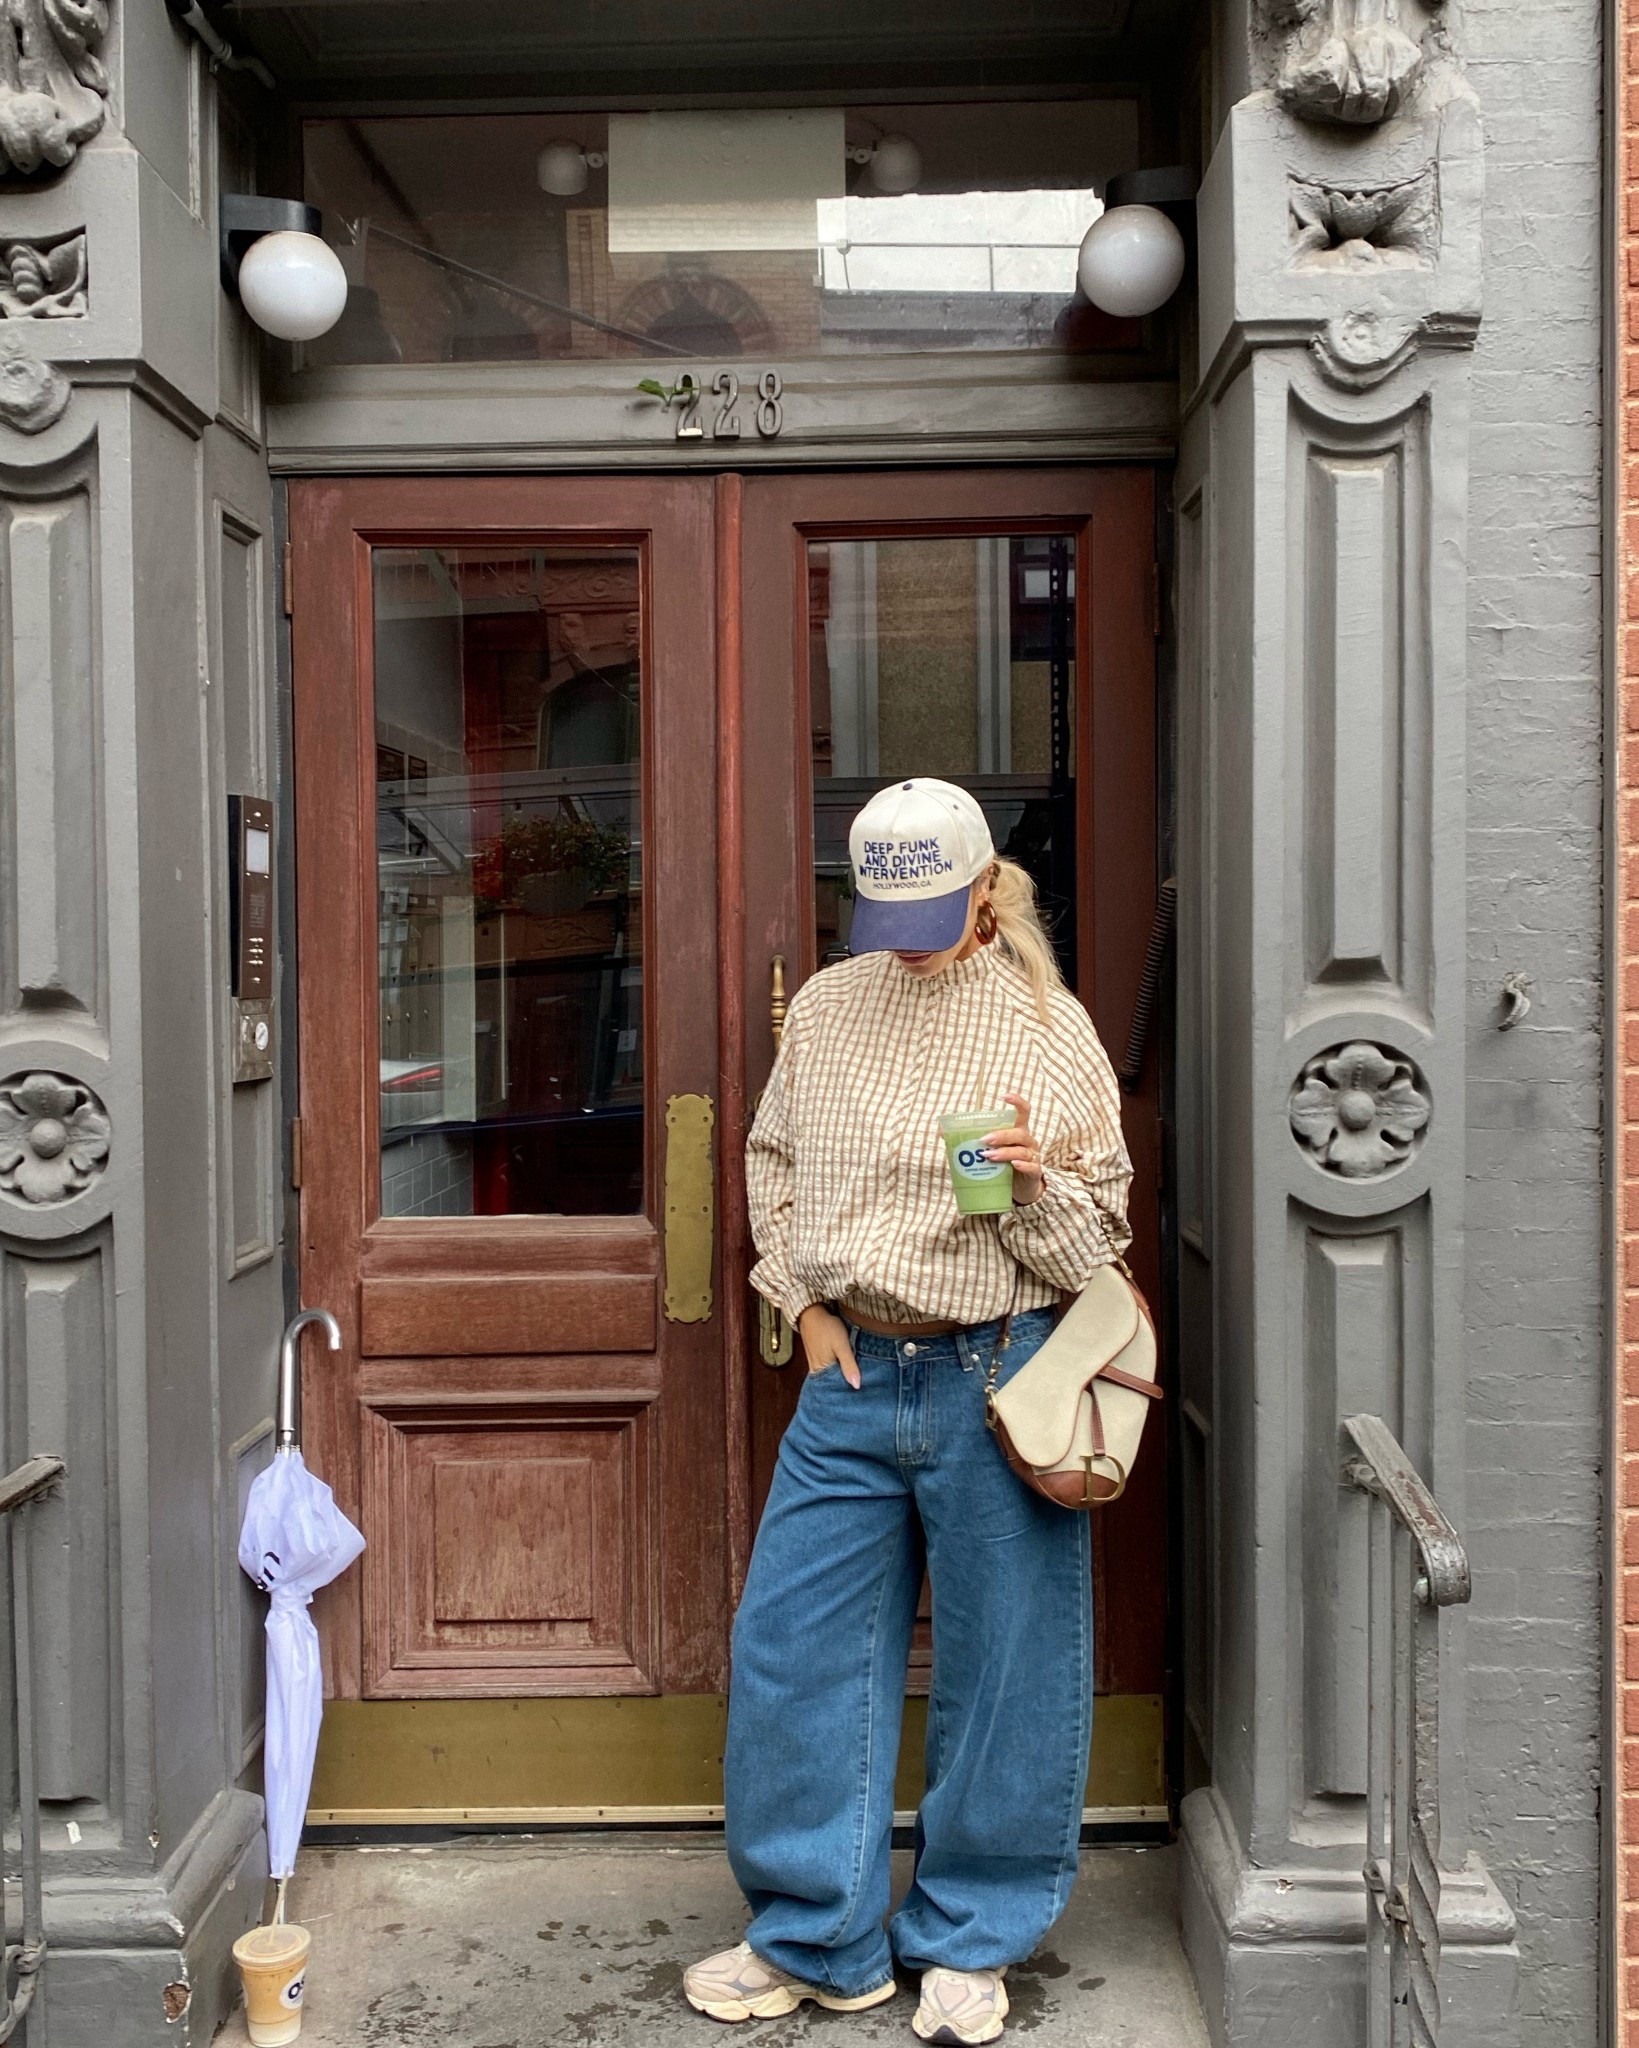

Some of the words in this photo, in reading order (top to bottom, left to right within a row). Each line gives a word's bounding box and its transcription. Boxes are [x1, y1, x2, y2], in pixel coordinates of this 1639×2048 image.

[675, 368, 783, 440] 228
[864, 841, 894, 854] DEEP
[899, 837, 939, 853] FUNK
[865, 854, 888, 867] AND
[893, 850, 941, 867] DIVINE
